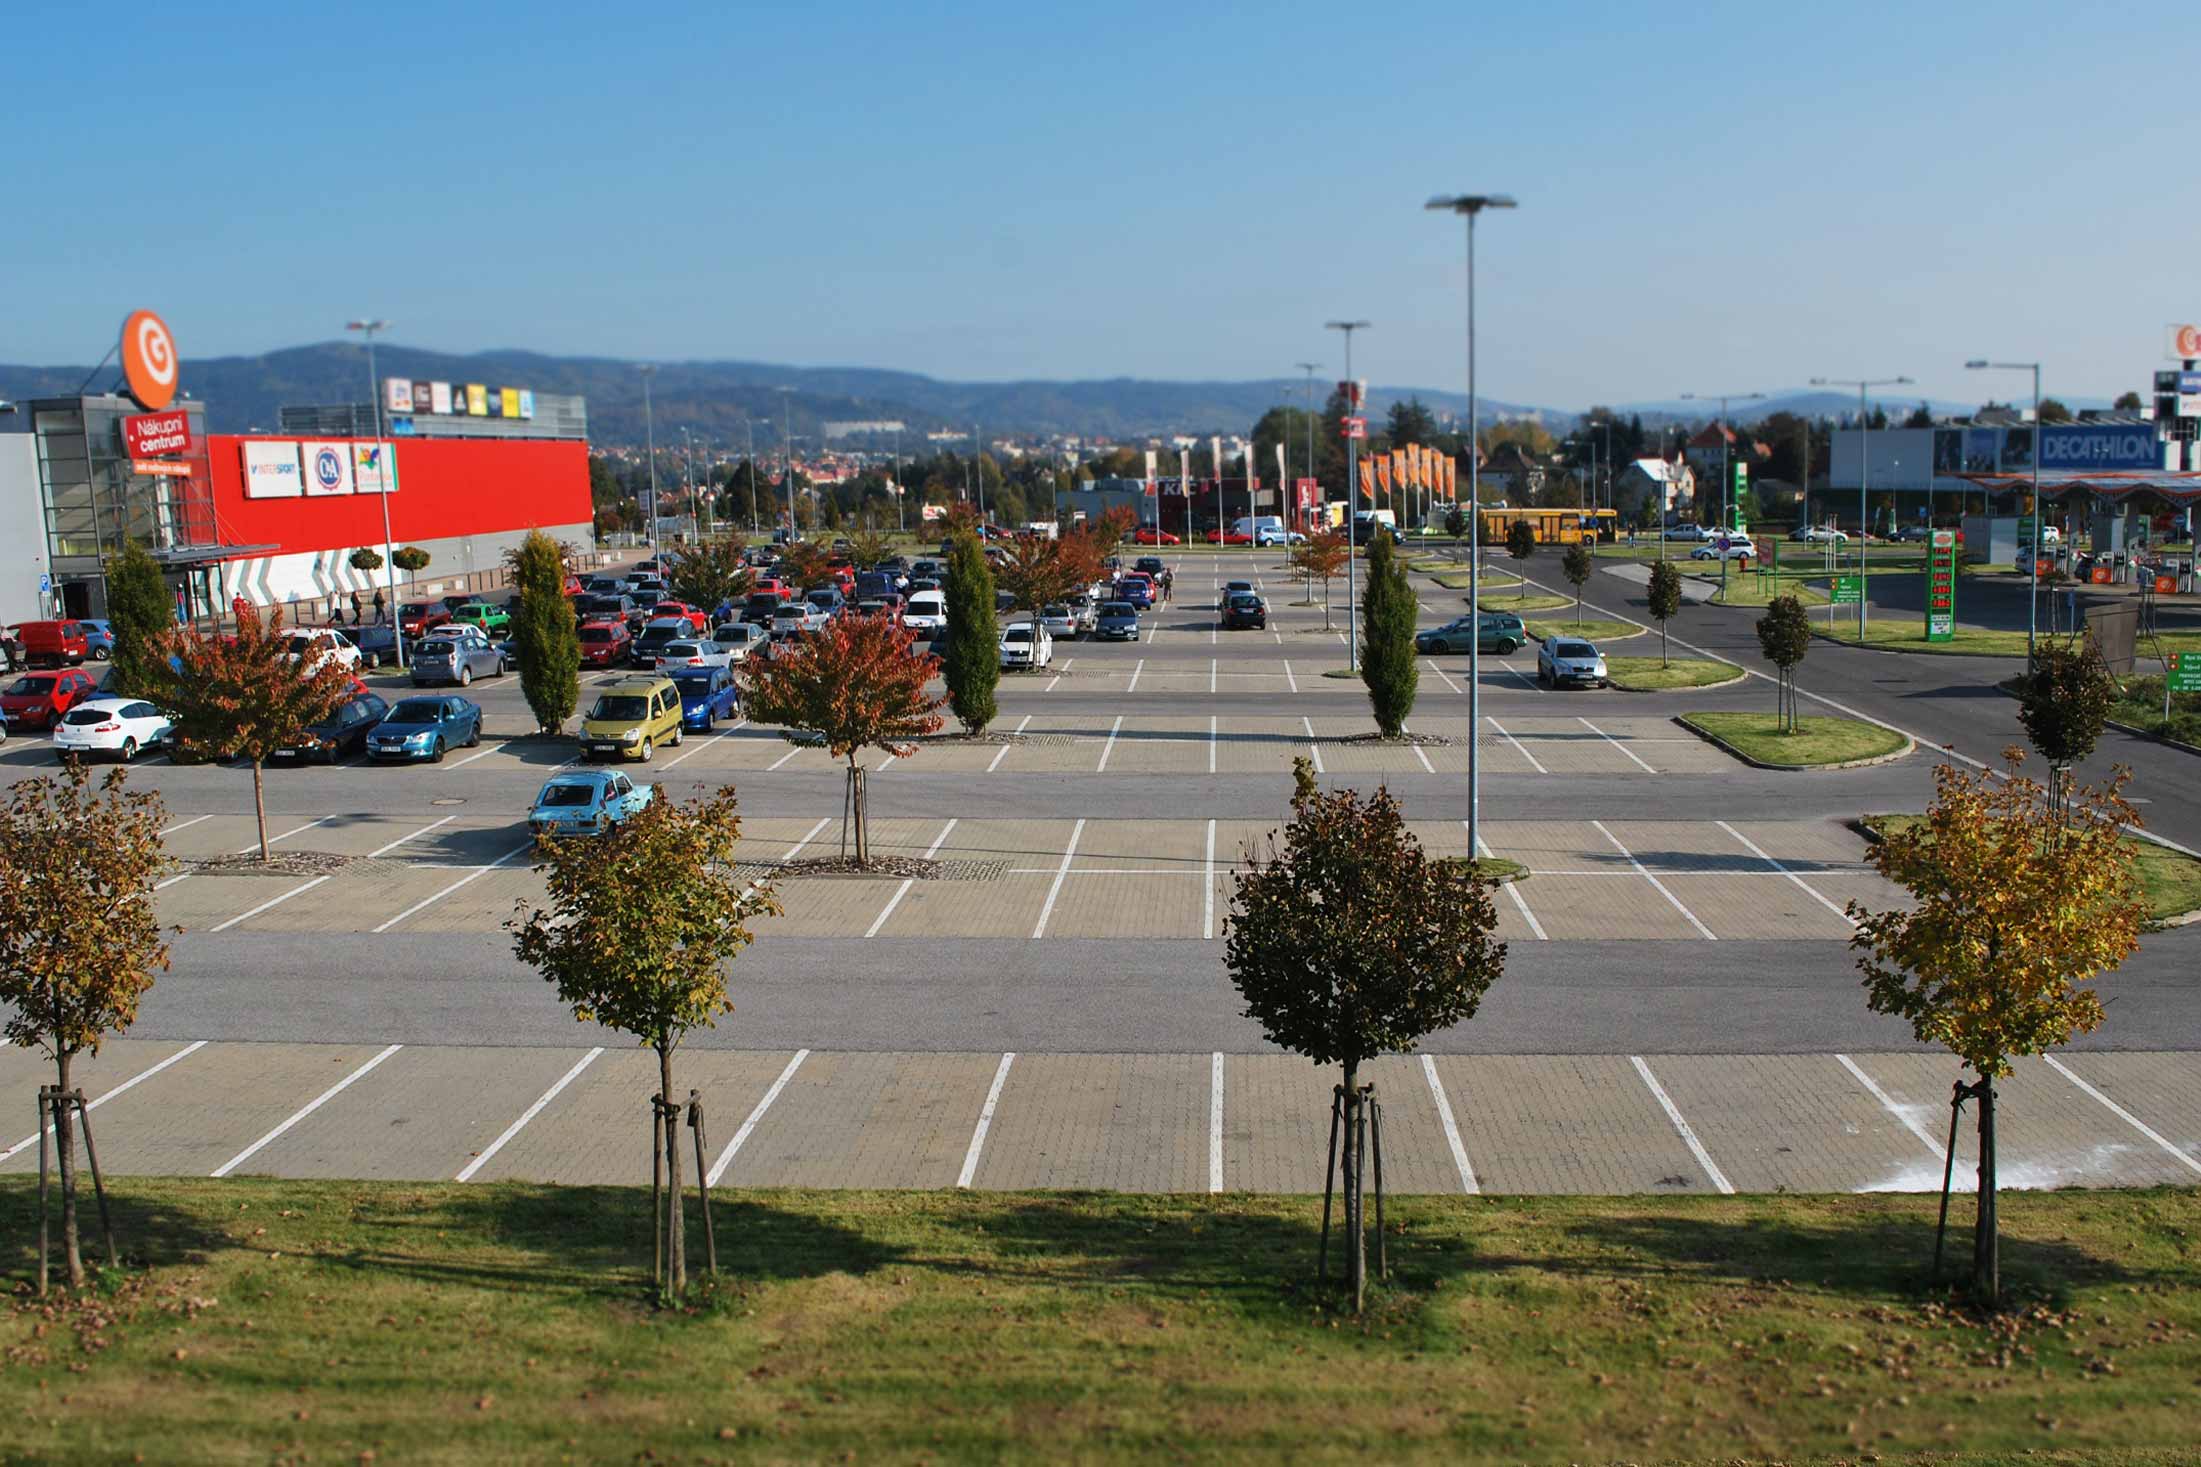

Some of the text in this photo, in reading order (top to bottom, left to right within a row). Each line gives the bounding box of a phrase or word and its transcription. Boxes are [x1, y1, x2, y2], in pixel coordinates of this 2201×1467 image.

[137, 416, 183, 437] Nákupní
[140, 434, 186, 452] centrum
[2043, 434, 2156, 460] DECATHLON
[1164, 482, 1198, 496] KC
